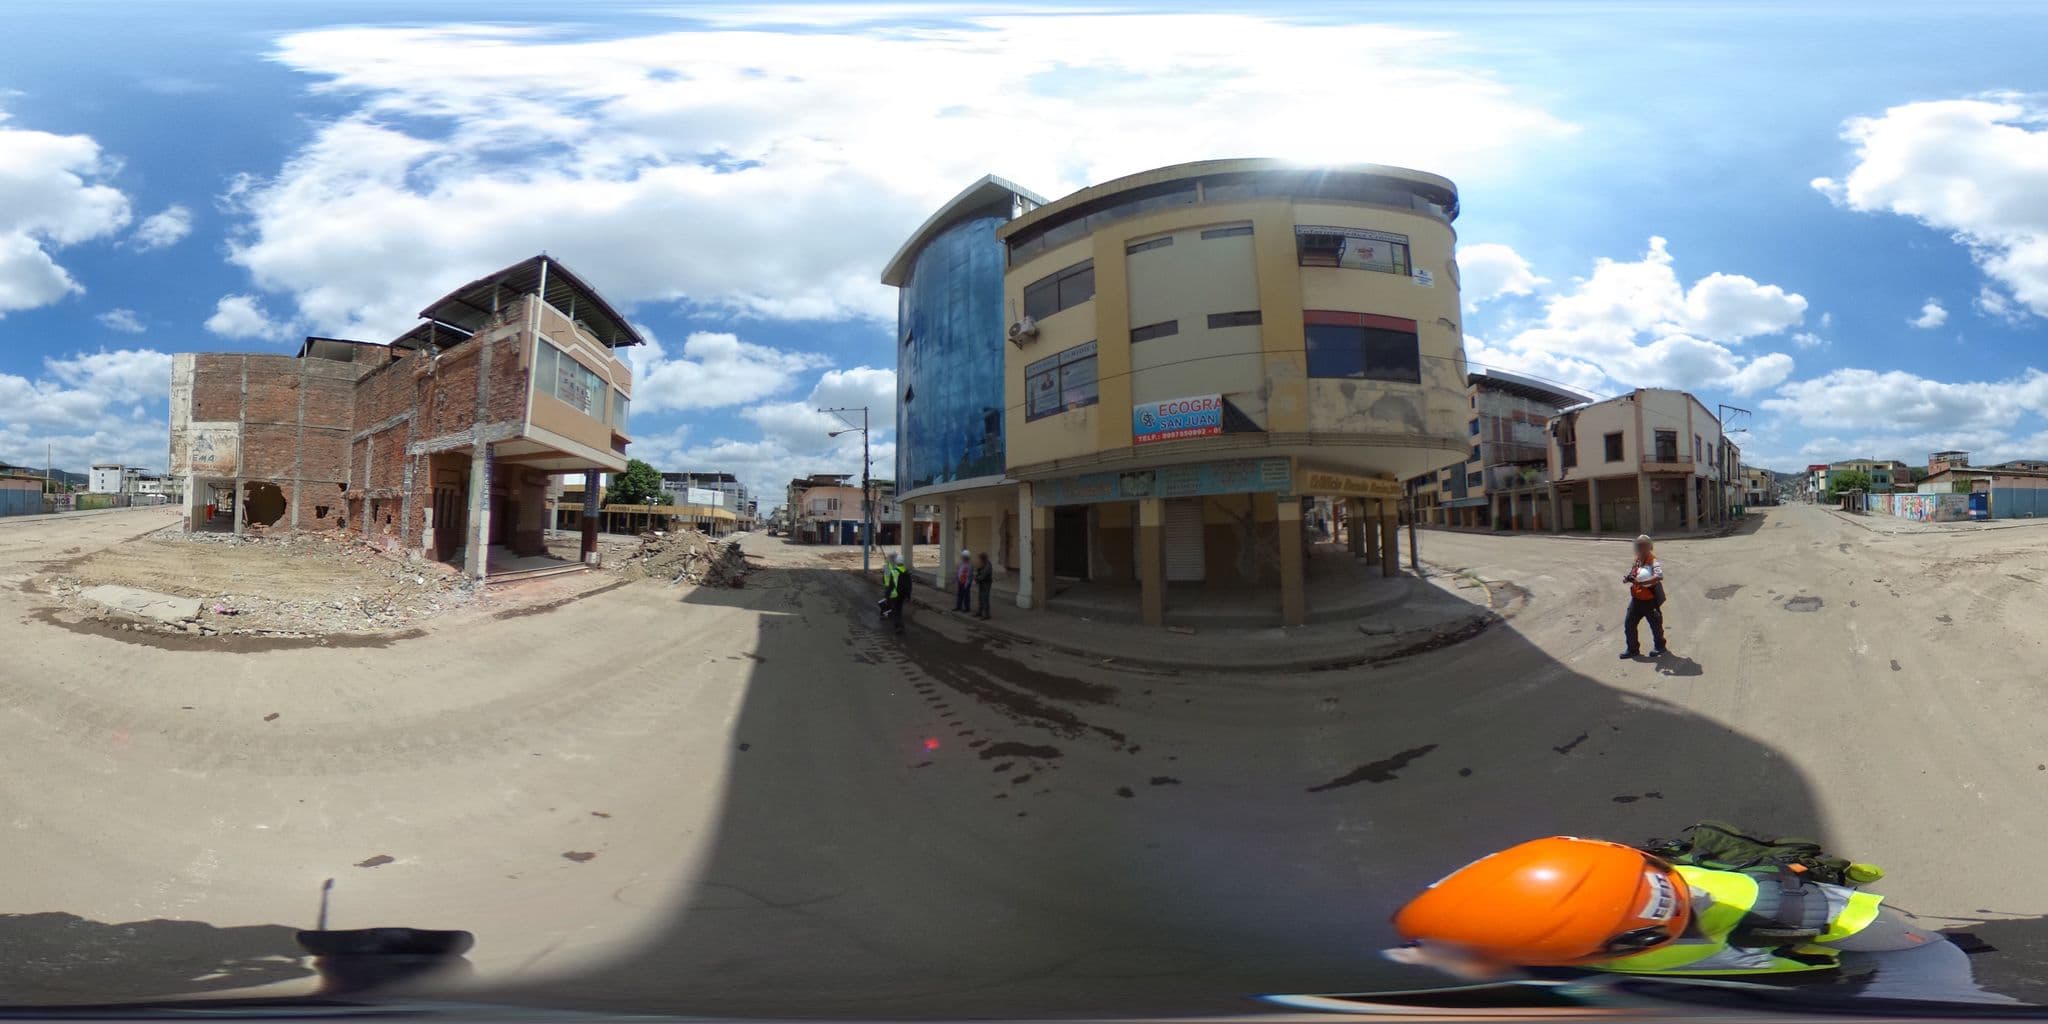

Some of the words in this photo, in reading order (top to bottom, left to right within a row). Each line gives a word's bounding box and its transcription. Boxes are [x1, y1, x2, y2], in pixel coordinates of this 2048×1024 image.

[1159, 397, 1223, 416] ECOGRA
[1160, 417, 1182, 429] SAN
[1186, 415, 1216, 427] JUAN
